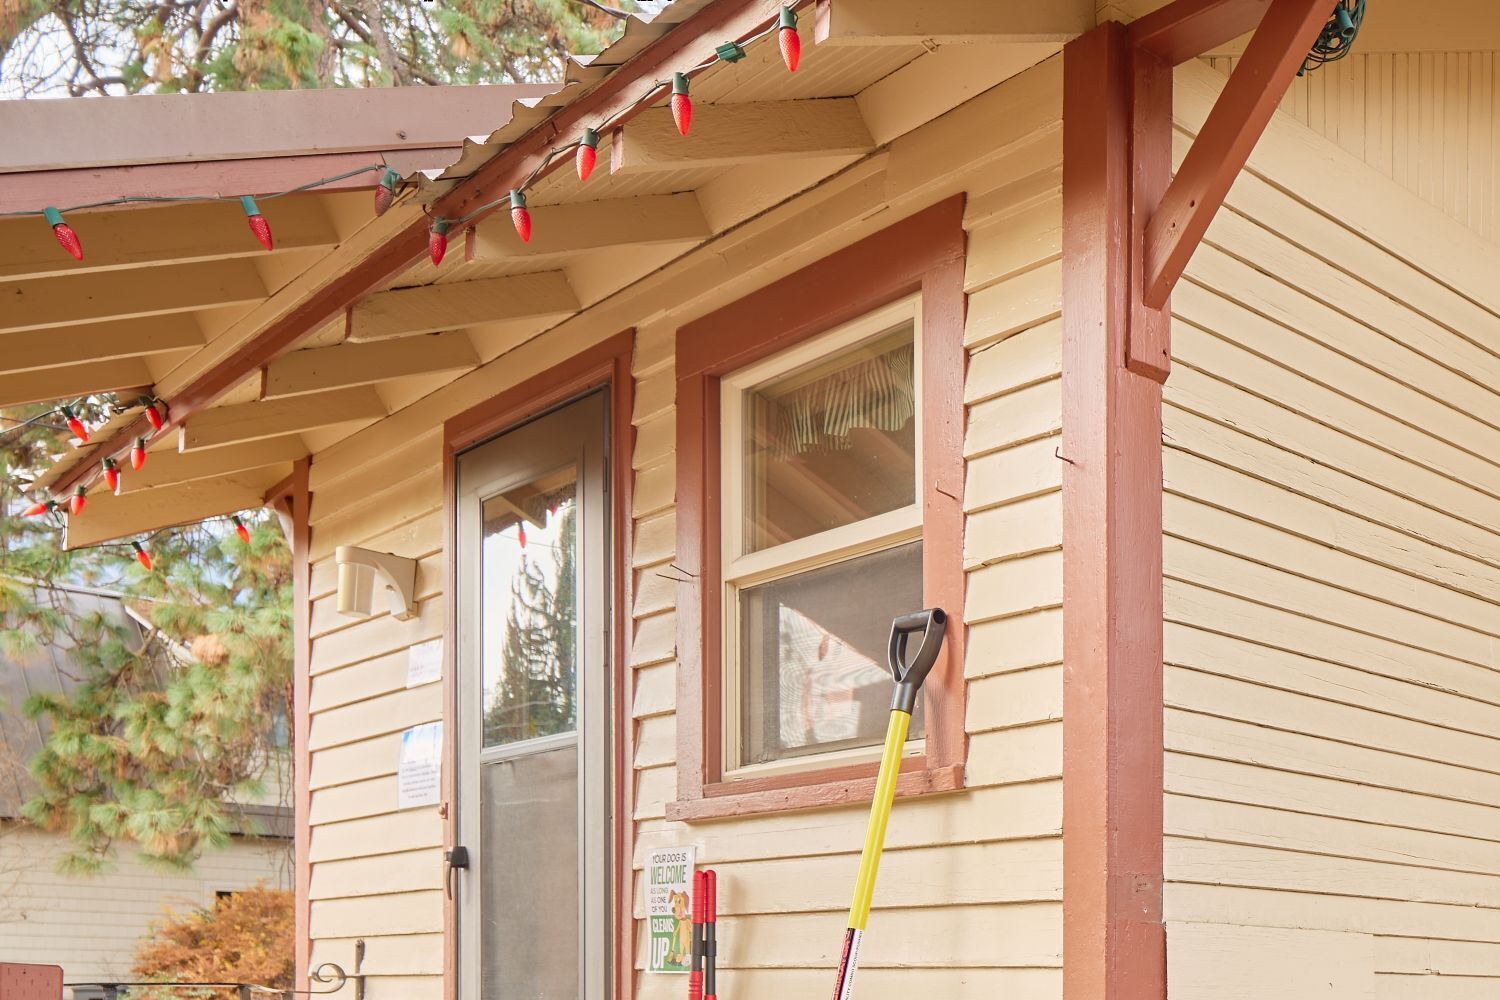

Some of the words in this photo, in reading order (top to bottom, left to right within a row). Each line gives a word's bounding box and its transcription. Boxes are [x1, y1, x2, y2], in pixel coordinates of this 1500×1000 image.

[652, 854, 667, 864] YOUR
[667, 853, 681, 863] DOG
[681, 853, 687, 861] IS
[650, 864, 687, 885] WELCOME
[652, 918, 675, 933] CLEANS
[652, 937, 670, 969] UP
